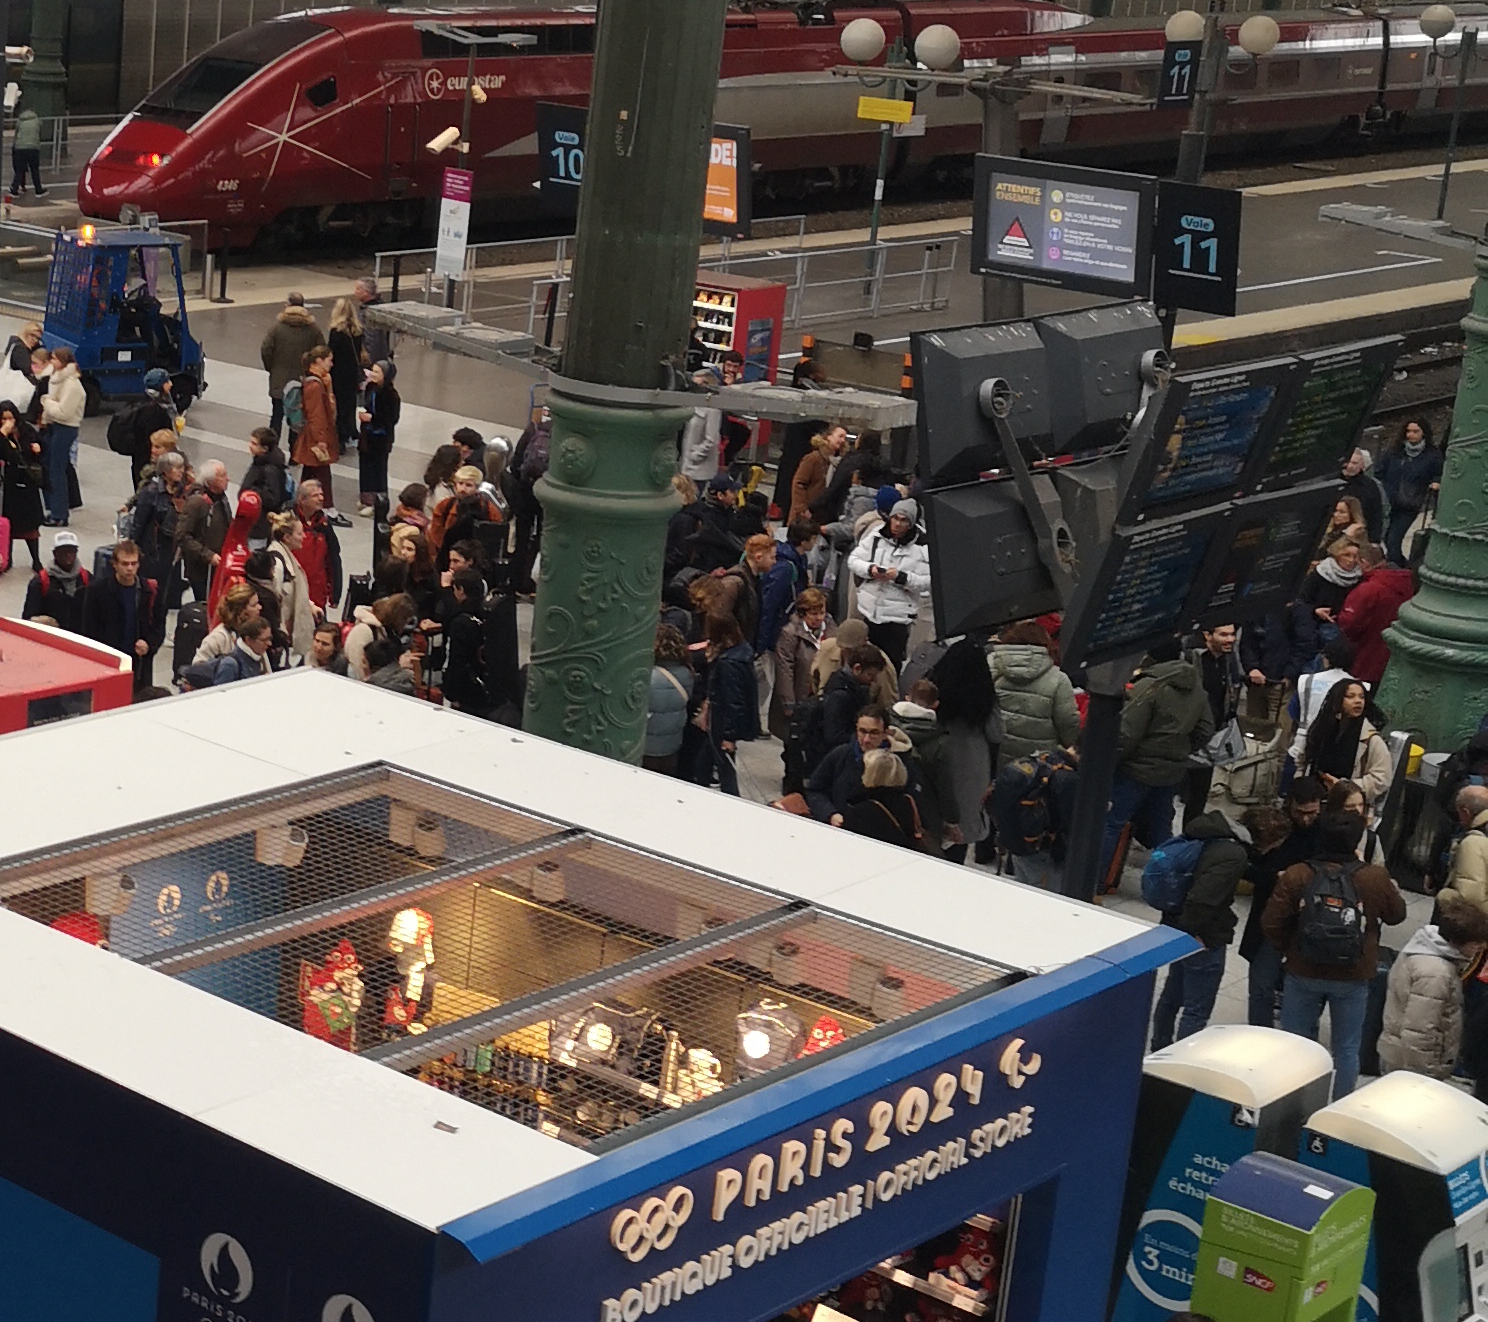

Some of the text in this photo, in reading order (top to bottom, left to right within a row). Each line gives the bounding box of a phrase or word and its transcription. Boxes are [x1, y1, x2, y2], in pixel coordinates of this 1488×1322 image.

[1169, 64, 1191, 94] 11
[558, 132, 576, 143] Voie
[550, 146, 585, 180] 10
[995, 182, 1042, 197] ATTENTIFS
[995, 191, 1042, 206] ENSEMBLE
[1185, 217, 1210, 230] Voie
[1173, 233, 1218, 273] 11
[712, 1063, 984, 1222] PARIS 2024
[1192, 1152, 1231, 1174] acha
[734, 1184, 865, 1269] OFFICIELLE
[875, 1136, 969, 1202] OFFICIAL
[968, 1105, 1035, 1158] STORE
[1167, 1176, 1210, 1201] écha
[1184, 1166, 1221, 1186] retr
[1141, 1245, 1160, 1272] 3
[1243, 1273, 1275, 1290] SNCF
[181, 1285, 224, 1317] PARIS
